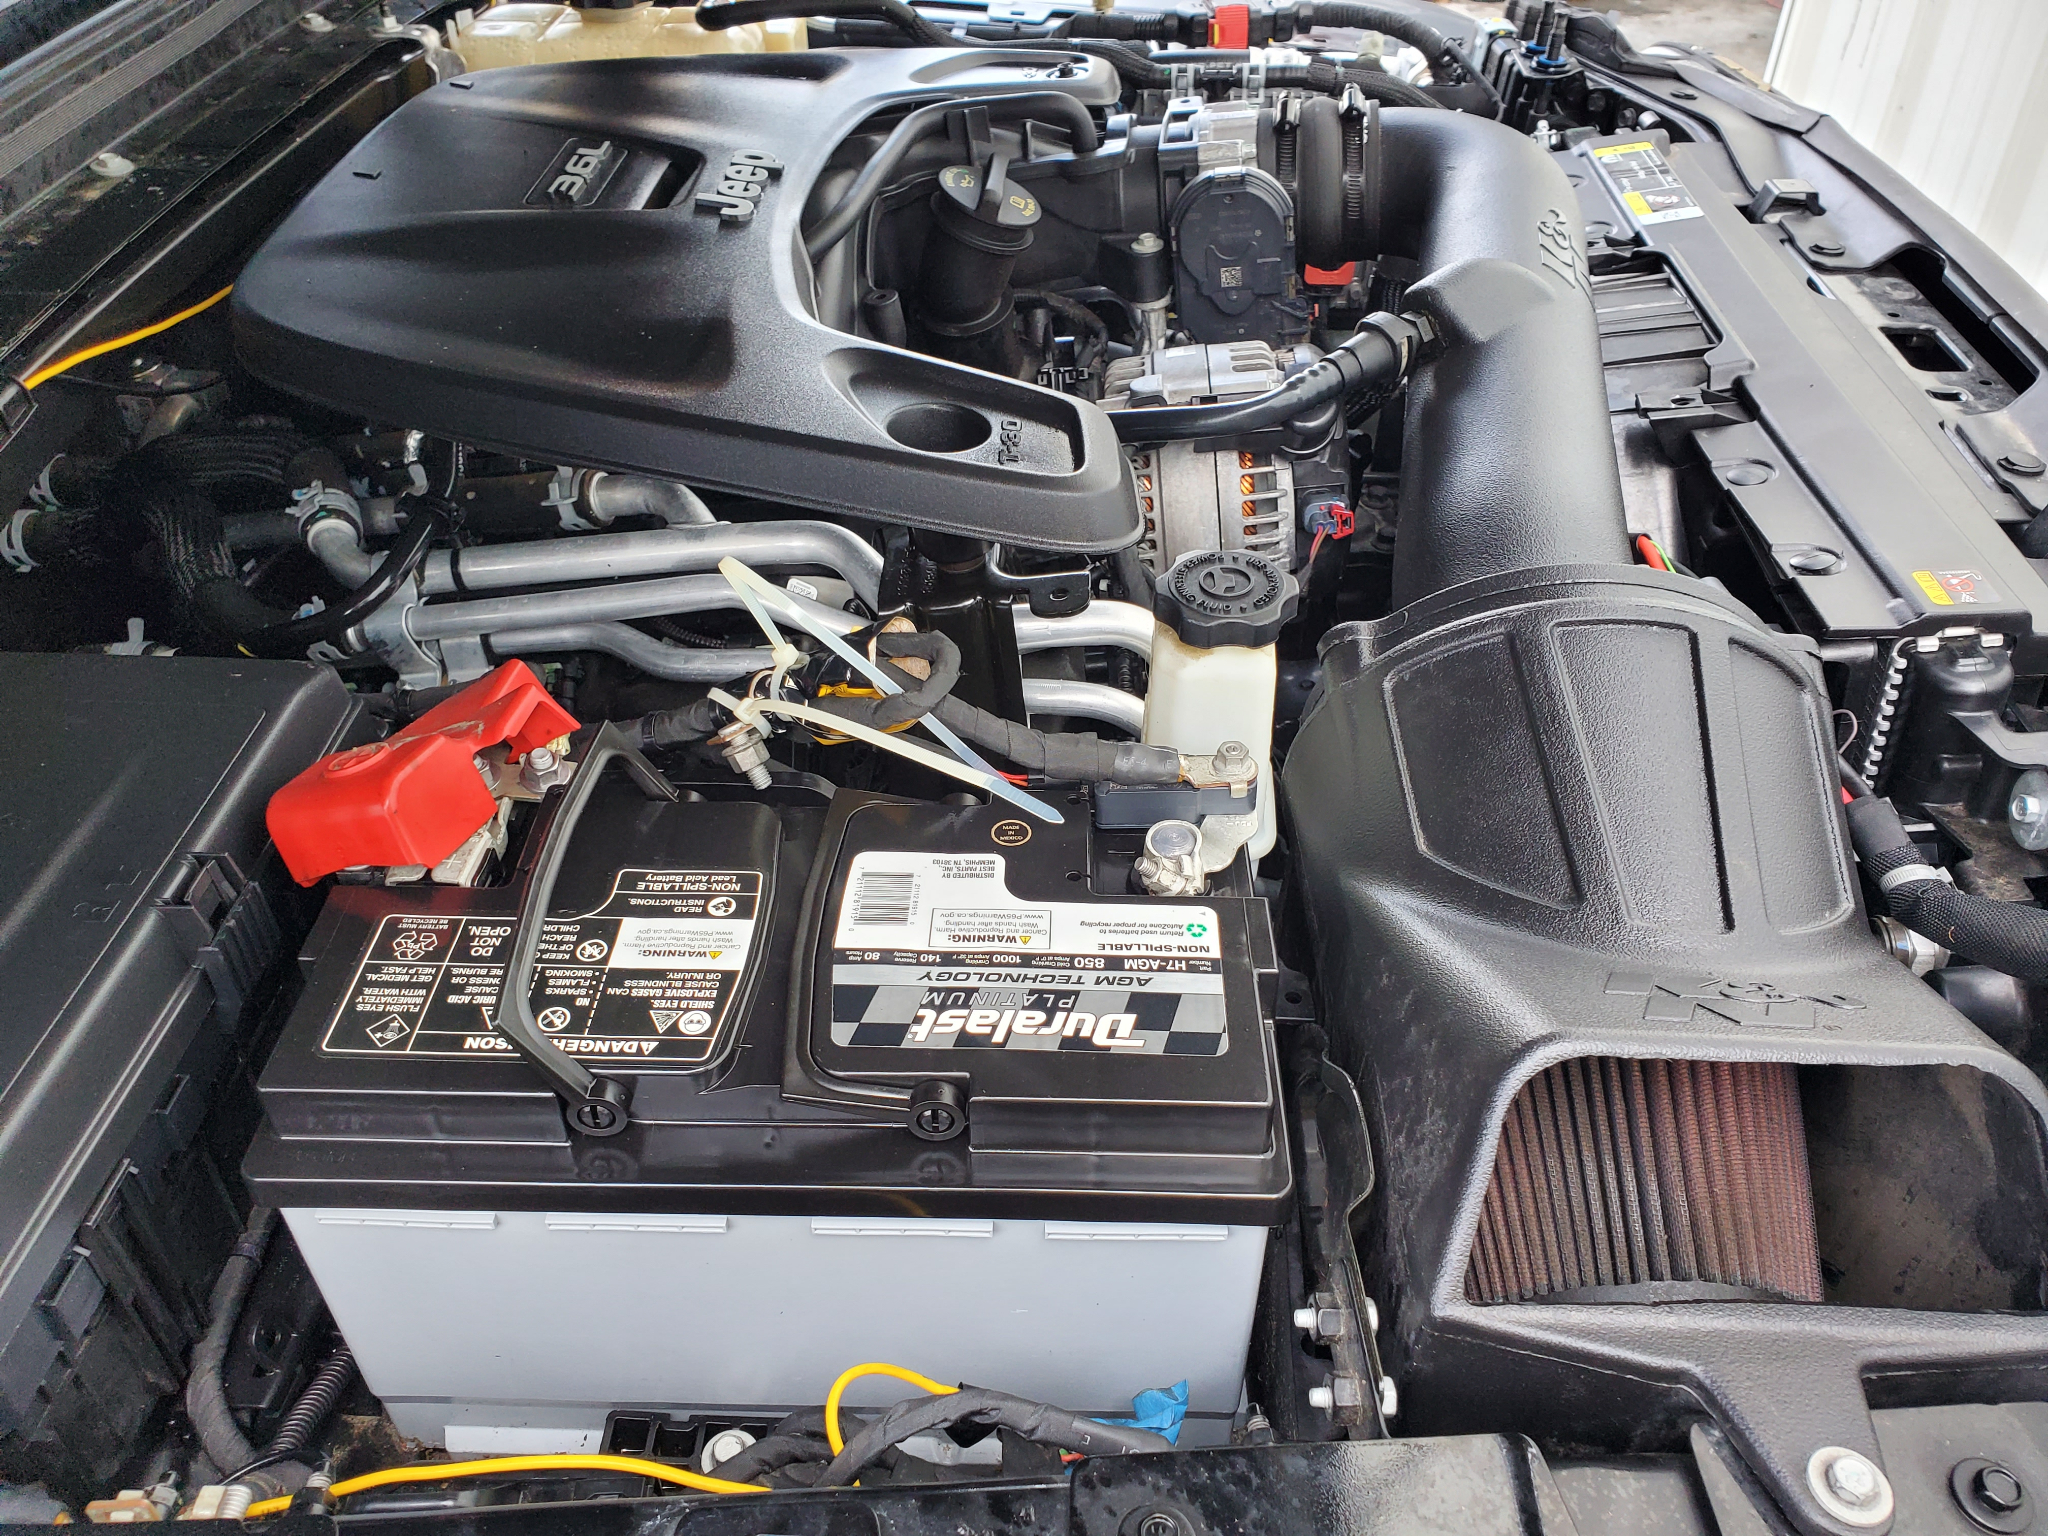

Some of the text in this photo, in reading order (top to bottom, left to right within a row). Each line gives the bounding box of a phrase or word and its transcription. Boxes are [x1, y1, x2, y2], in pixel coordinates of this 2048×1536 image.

[694, 149, 784, 219] Jeep
[998, 420, 1022, 465] T-30
[1175, 553, 1232, 610] POWER STEERING FLUID
[1246, 556, 1279, 605] USE APPROVED
[636, 882, 741, 891] NON-SPILLABLE
[468, 926, 511, 935] OPEN.
[637, 928, 733, 936] www.P65Warnings.ca.gov
[470, 937, 502, 946] NOT
[947, 935, 1017, 943] WARNING:
[471, 946, 493, 956] DO
[1097, 943, 1210, 953] NON-SPILLABLE
[638, 949, 707, 958] WARNING:
[865, 951, 880, 960] 80
[920, 954, 941, 962] 140
[993, 954, 1021, 963] 1000
[1075, 957, 1104, 968] 850
[1124, 959, 1186, 970] H7-AGM
[469, 976, 500, 984] DNESS
[916, 970, 1154, 986] AGM TECHNOLOGY
[684, 980, 719, 988] CAUSE
[362, 987, 399, 995] WATER.
[631, 988, 662, 996] GASES
[664, 988, 717, 997] EXPLOSIVE
[471, 995, 496, 1003] URIC
[576, 998, 590, 1006] NO
[920, 991, 1075, 1008] PLATINUM
[385, 1004, 420, 1012] FLUSH
[650, 1000, 715, 1008] SHIELD EYES.
[910, 1009, 1146, 1047] Duralast
